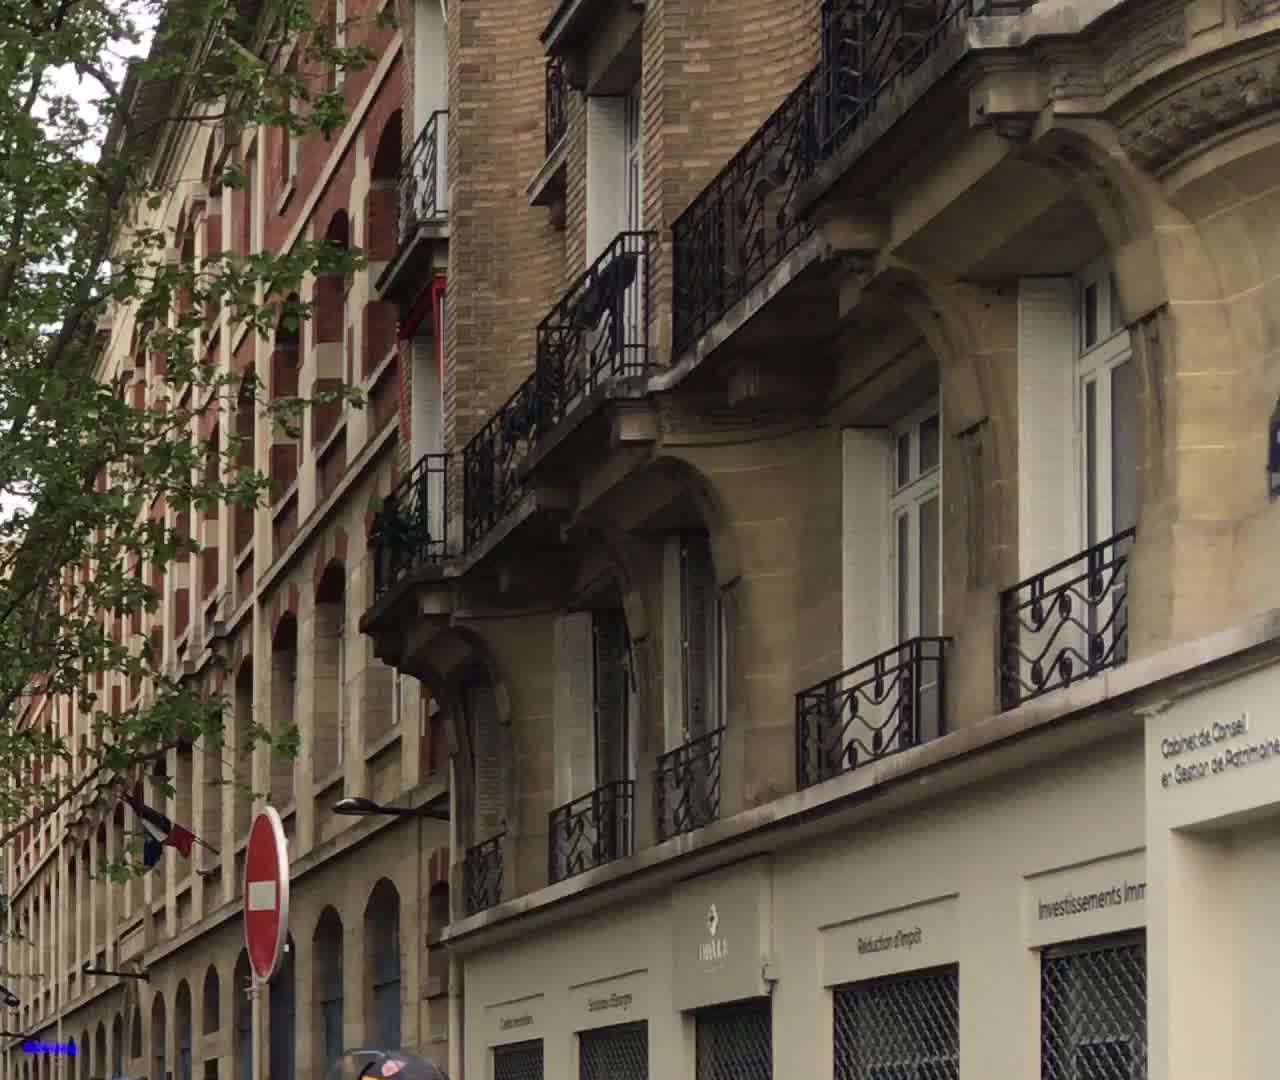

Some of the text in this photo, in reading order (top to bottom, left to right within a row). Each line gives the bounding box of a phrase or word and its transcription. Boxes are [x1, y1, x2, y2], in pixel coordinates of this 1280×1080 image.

[1161, 712, 1247, 759] Cabinet de Conseil
[1161, 772, 1173, 790] en
[1175, 760, 1209, 785] Gestion
[1211, 755, 1225, 775] de
[1038, 886, 1122, 920] Investissements
